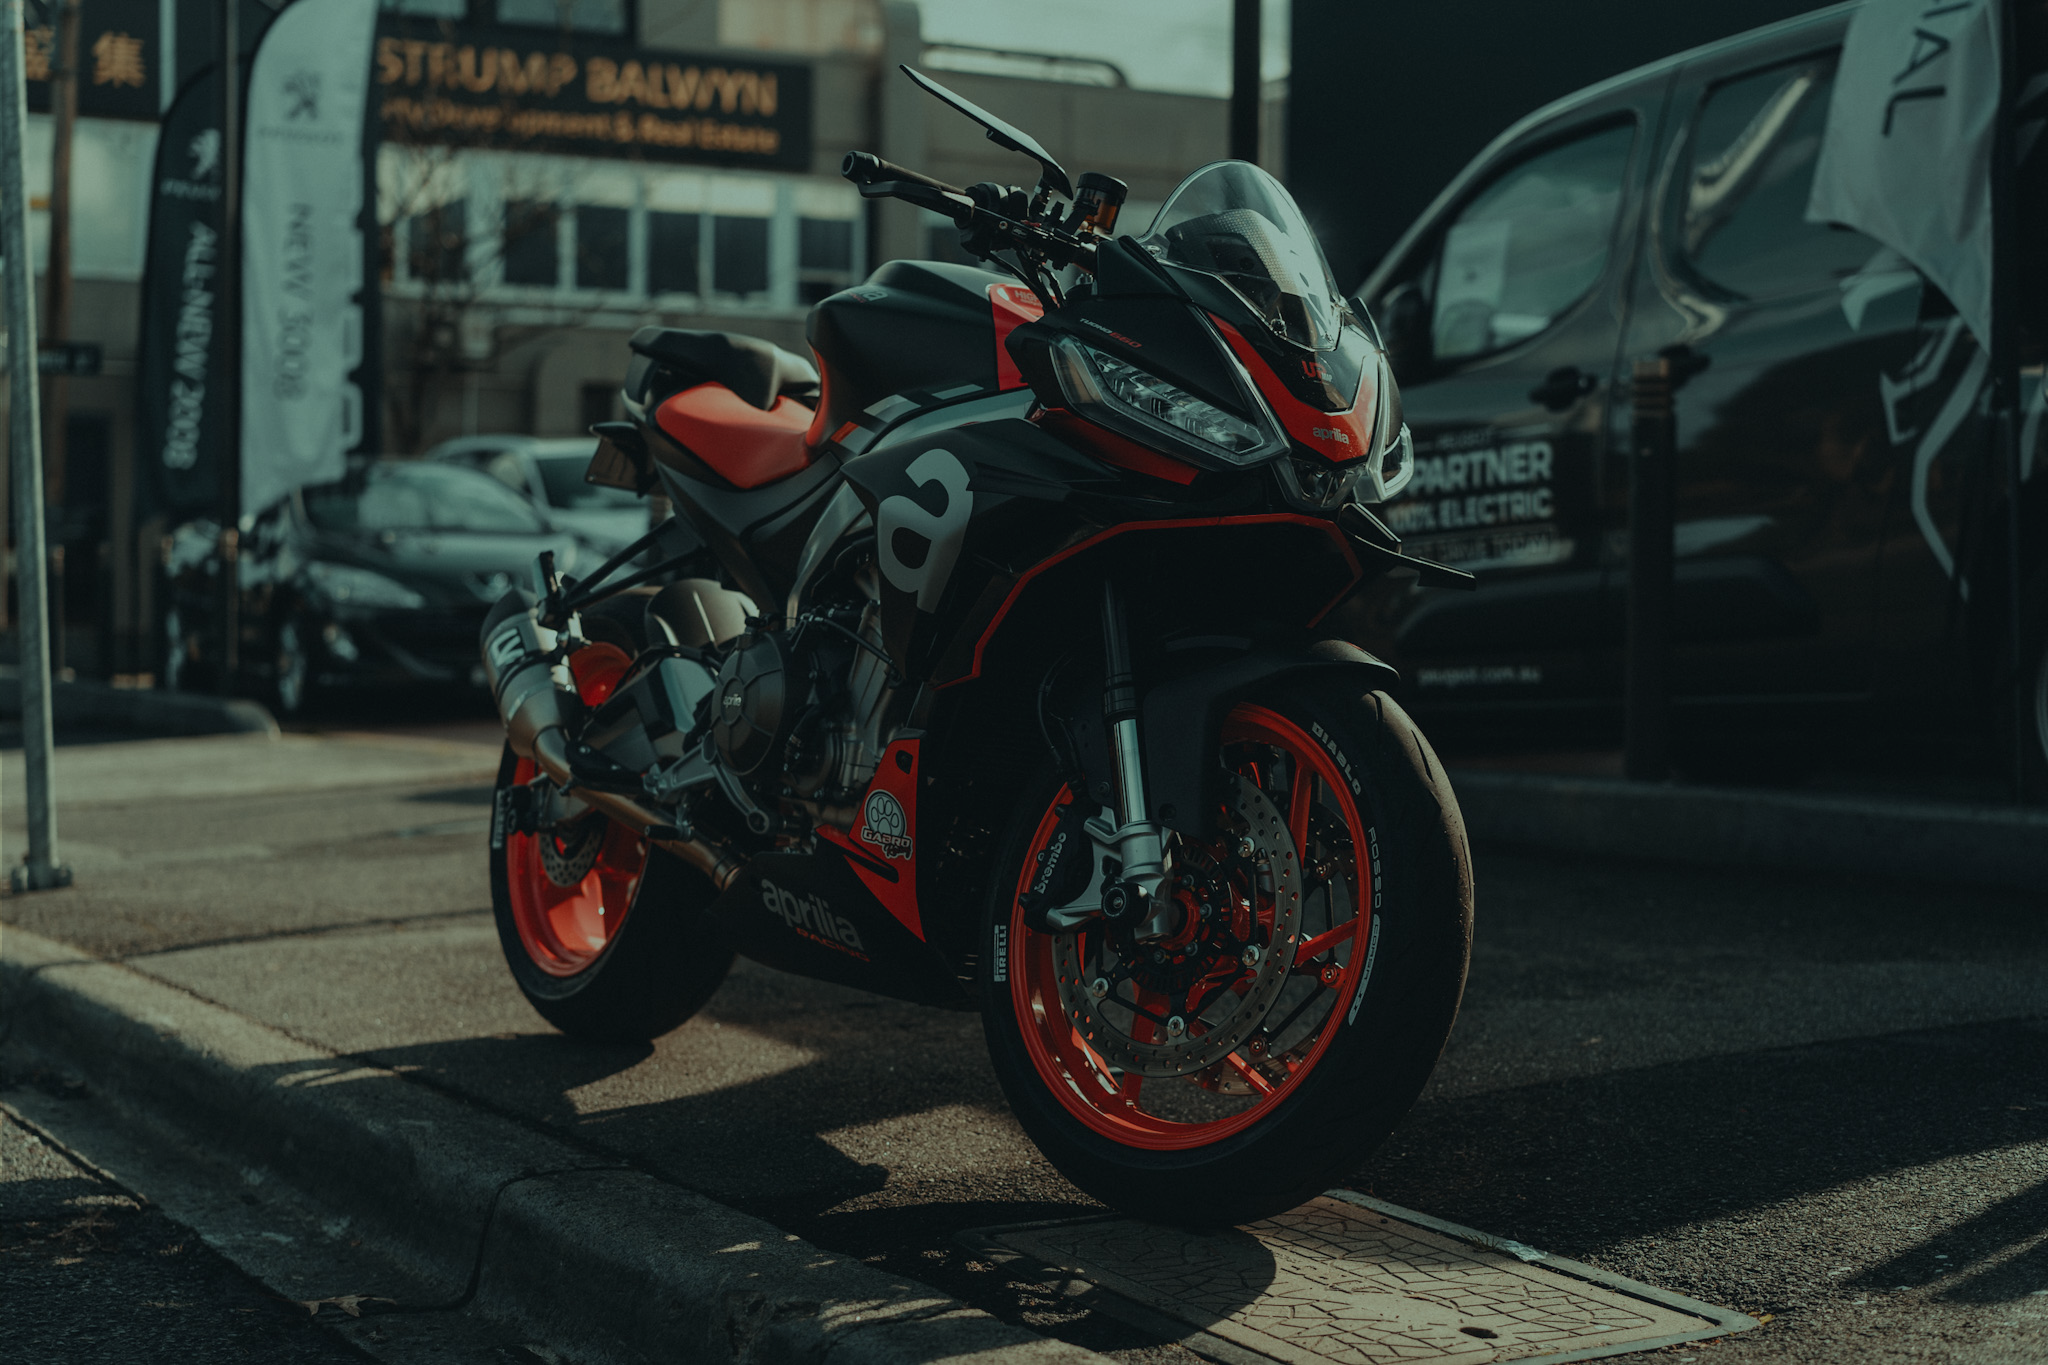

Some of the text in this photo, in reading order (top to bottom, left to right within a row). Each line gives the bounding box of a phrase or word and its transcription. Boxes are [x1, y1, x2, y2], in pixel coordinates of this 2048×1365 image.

[586, 57, 779, 118] BALWYN
[283, 202, 315, 301] NEW
[162, 376, 206, 470] 2008
[1312, 426, 1350, 445] aprilia
[1406, 441, 1554, 497] PARTNER
[1438, 487, 1555, 528] ELECTRIC
[1312, 721, 1361, 796] DIABLO
[1034, 832, 1067, 894] brembo
[1368, 826, 1382, 909] ROSSO
[761, 879, 864, 951] aprilia
[994, 924, 1007, 982] PIRELLI
